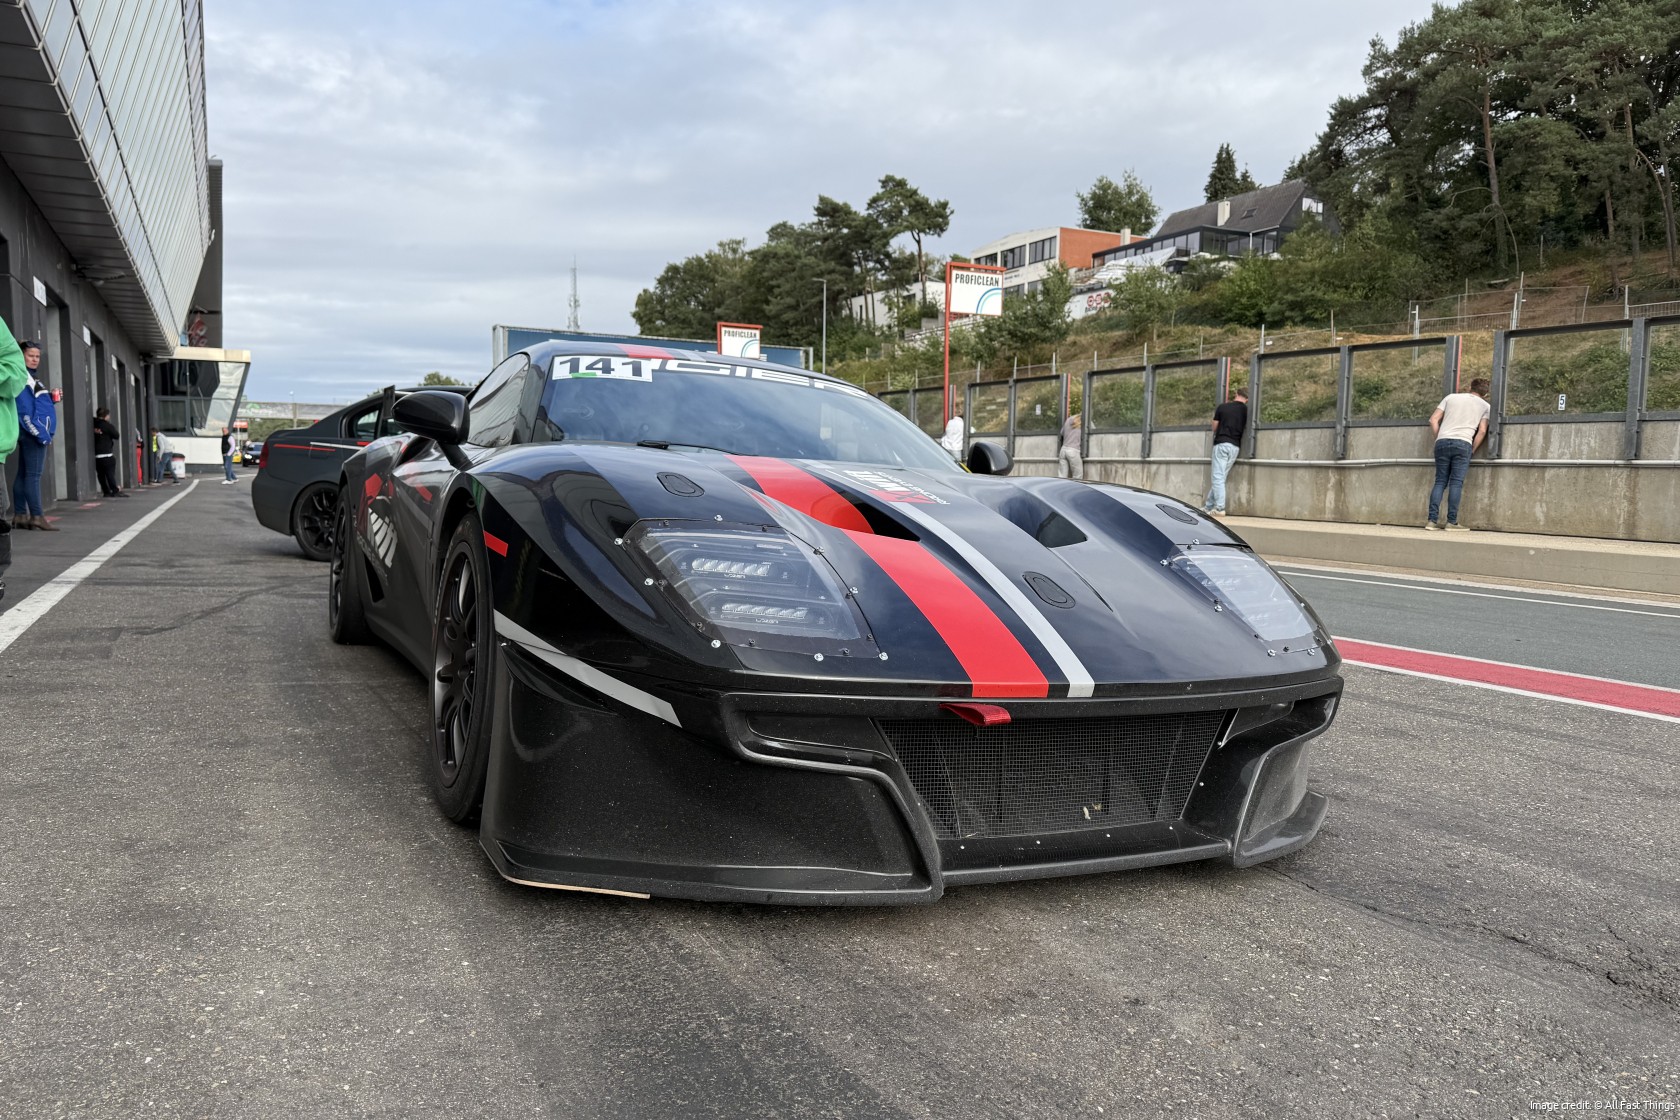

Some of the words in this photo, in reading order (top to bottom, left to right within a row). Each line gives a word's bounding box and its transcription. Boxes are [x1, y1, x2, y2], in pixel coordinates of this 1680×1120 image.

[954, 272, 1000, 287] PROFICLEAN
[723, 329, 757, 339] PROFICLEAN
[559, 356, 643, 378] 141
[1559, 395, 1565, 405] 5
